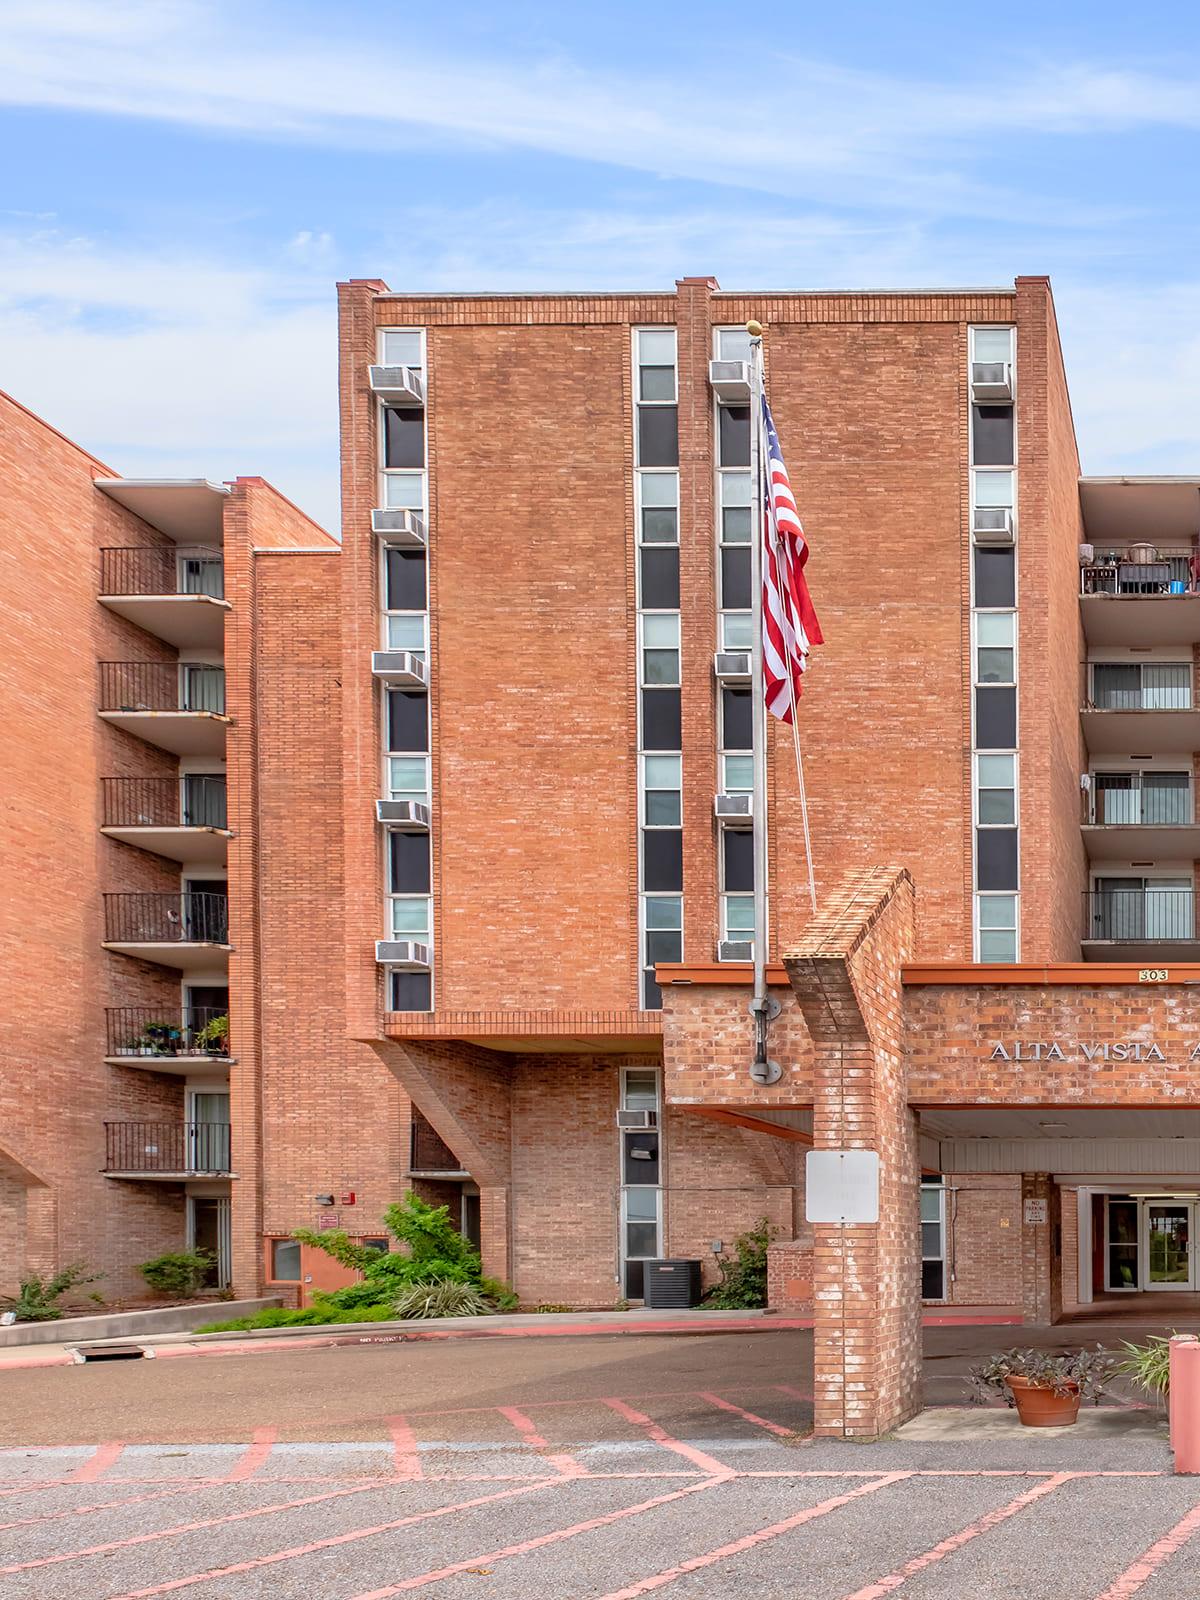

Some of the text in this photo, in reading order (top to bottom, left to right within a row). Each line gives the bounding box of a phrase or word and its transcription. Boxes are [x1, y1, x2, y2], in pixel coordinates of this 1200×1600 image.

[1140, 970, 1167, 980] 303
[990, 1042, 1066, 1061] ALTA
[1079, 1042, 1167, 1061] VISTA
